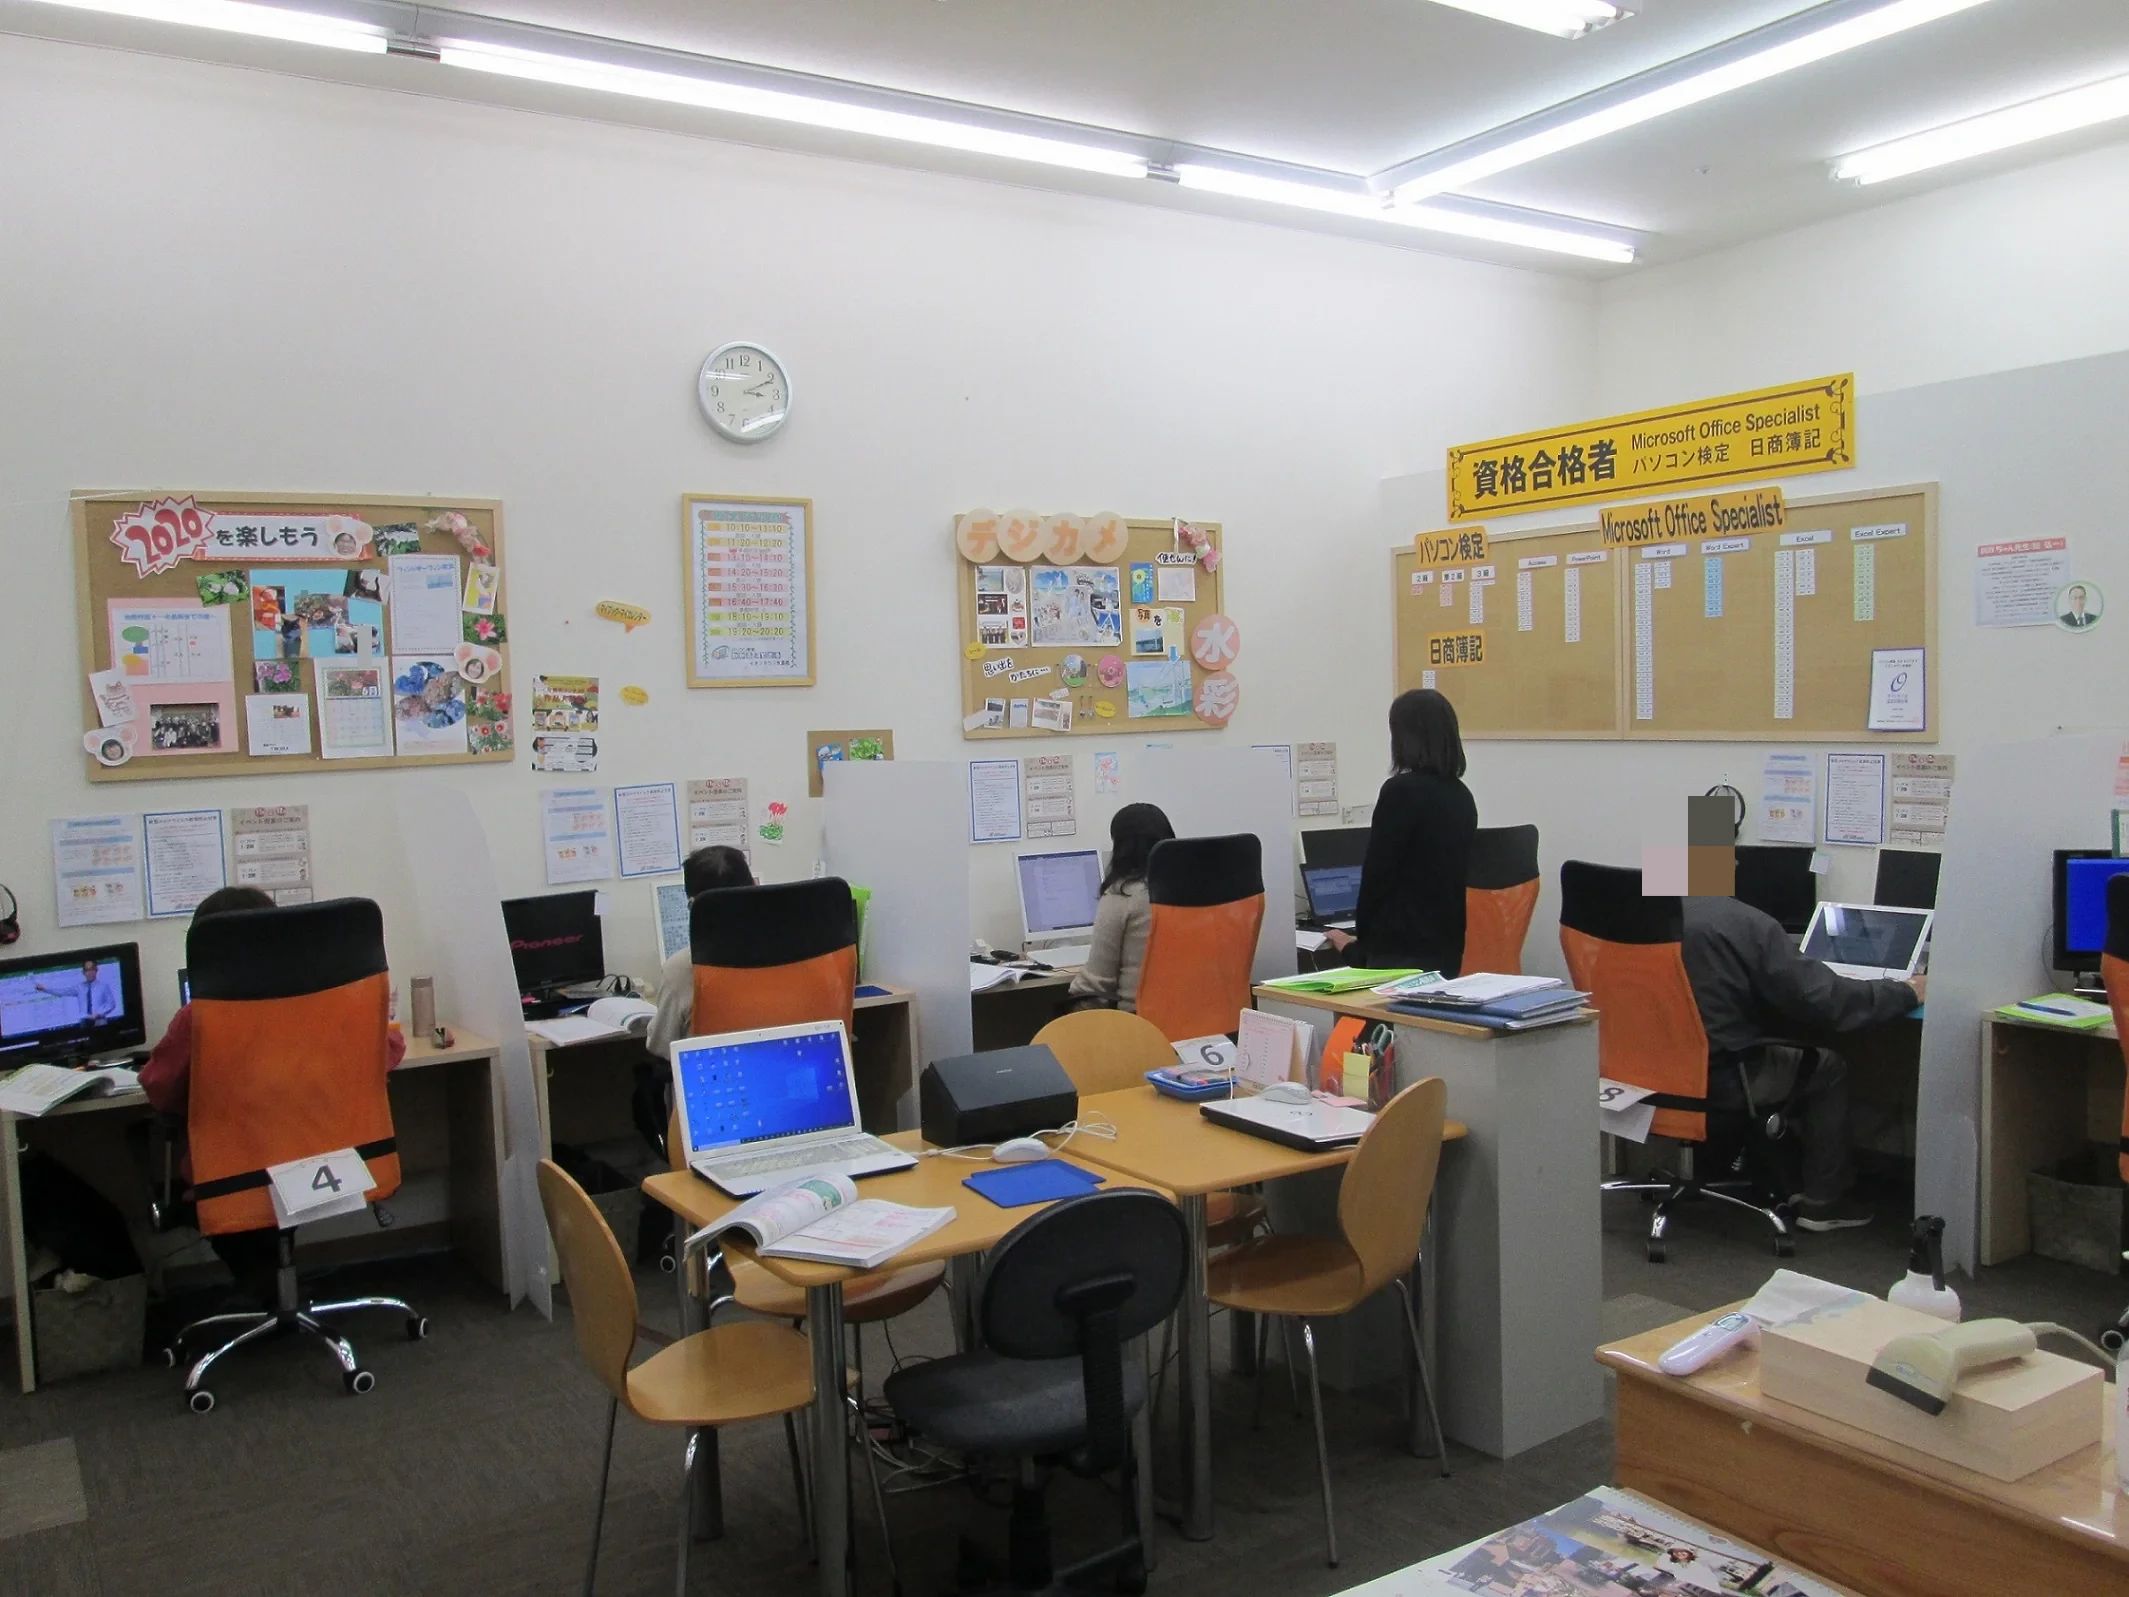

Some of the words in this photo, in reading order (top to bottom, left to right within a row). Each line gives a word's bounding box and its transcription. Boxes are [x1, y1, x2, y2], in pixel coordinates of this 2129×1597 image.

[725, 358, 734, 370] 11
[740, 354, 750, 367] 12
[758, 360, 762, 372] 1
[767, 372, 774, 384] 2
[710, 385, 719, 397] 9
[772, 389, 780, 400] 3
[717, 401, 725, 413] 8
[728, 413, 736, 425] 7
[1631, 424, 1696, 451] Microsoft
[1699, 419, 1741, 439] Office
[1745, 403, 1821, 432] Specialist
[1632, 443, 1730, 474] パソコン検定
[1751, 428, 1821, 457] 日商簿記
[1472, 438, 1618, 500] 資格合格者
[1601, 508, 1663, 544] Microsoft
[1665, 502, 1707, 536] Office
[1711, 493, 1783, 534] Specialist
[125, 508, 203, 564] 2020
[216, 525, 318, 548] を楽しもう
[967, 519, 1117, 557] デジカメ
[1876, 528, 1900, 536] Expert
[1419, 532, 1485, 564] パソコン検定
[1430, 635, 1483, 664] 日商簿記
[511, 933, 584, 950] Pioneer
[1200, 1044, 1225, 1066] 6
[1600, 1087, 1625, 1102] 8
[311, 1163, 344, 1194] 4
